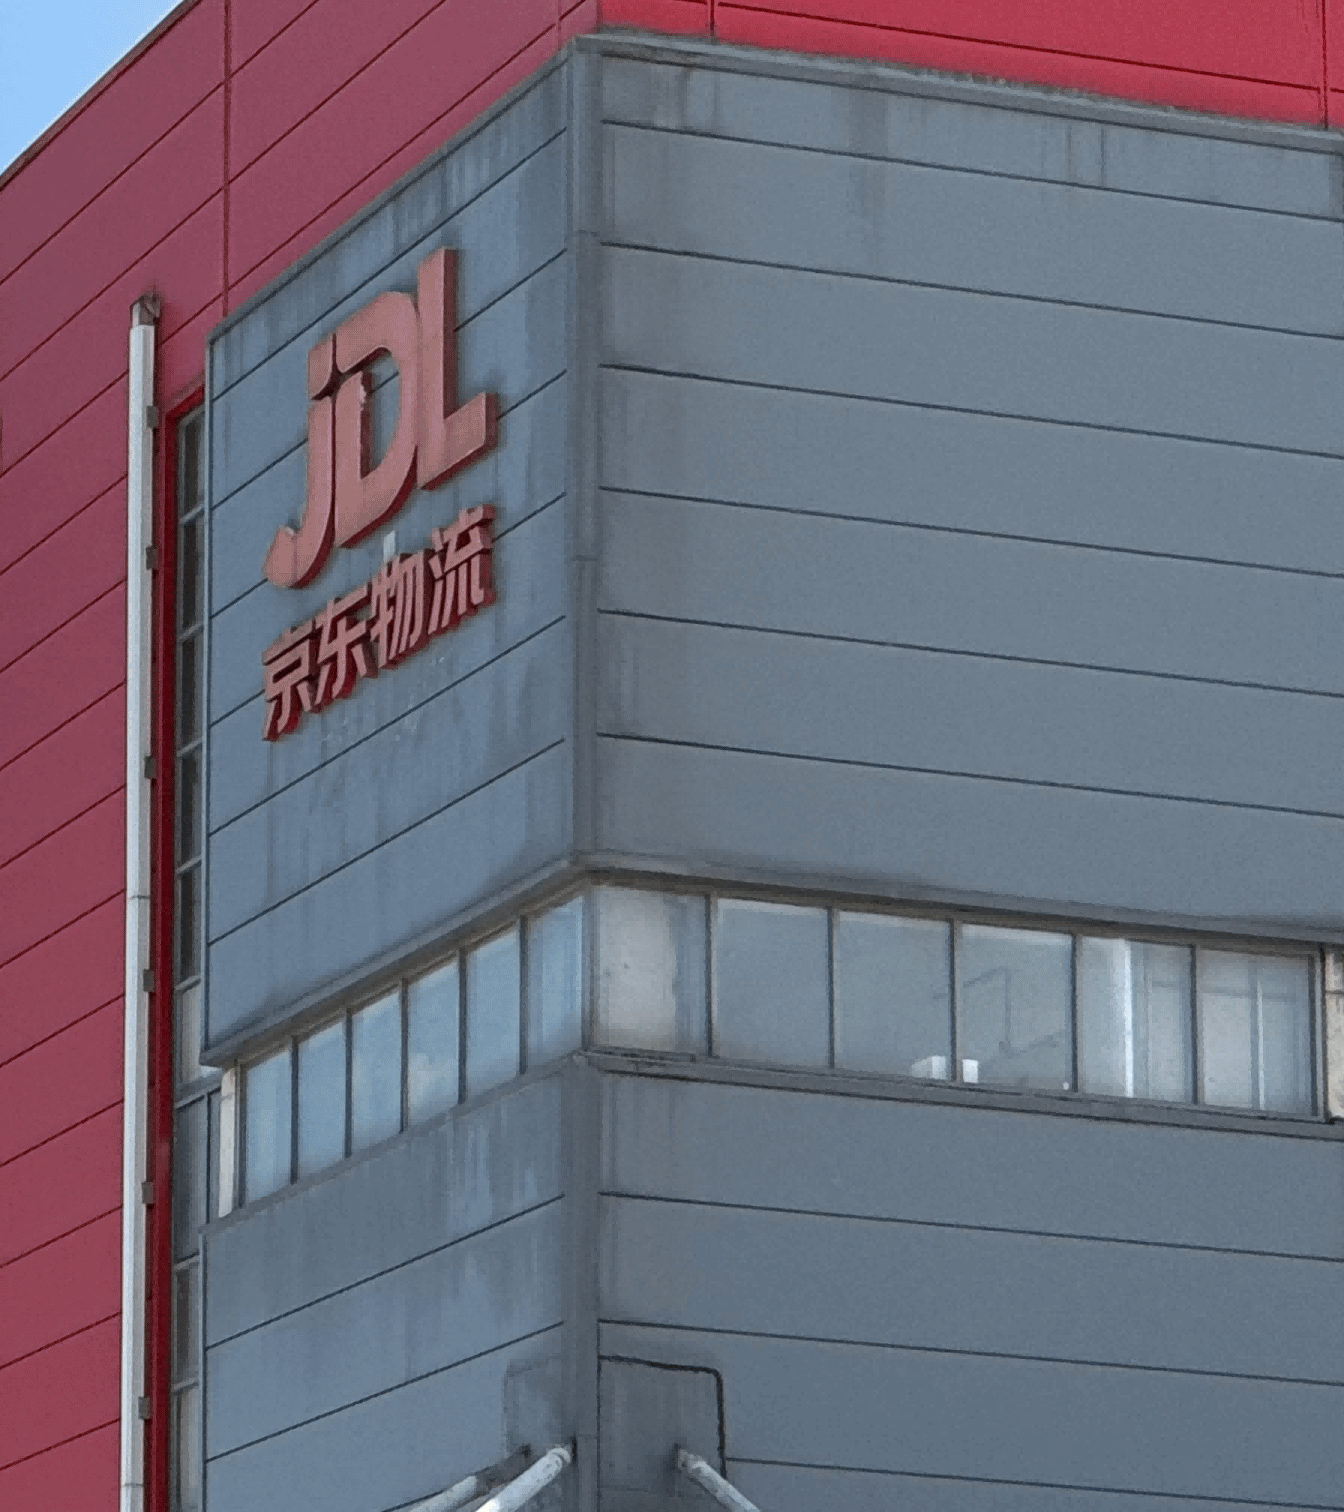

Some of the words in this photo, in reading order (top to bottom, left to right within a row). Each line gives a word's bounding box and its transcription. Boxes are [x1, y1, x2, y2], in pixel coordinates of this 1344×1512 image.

[264, 246, 496, 588] JDL
[262, 504, 498, 740] 京东物流
